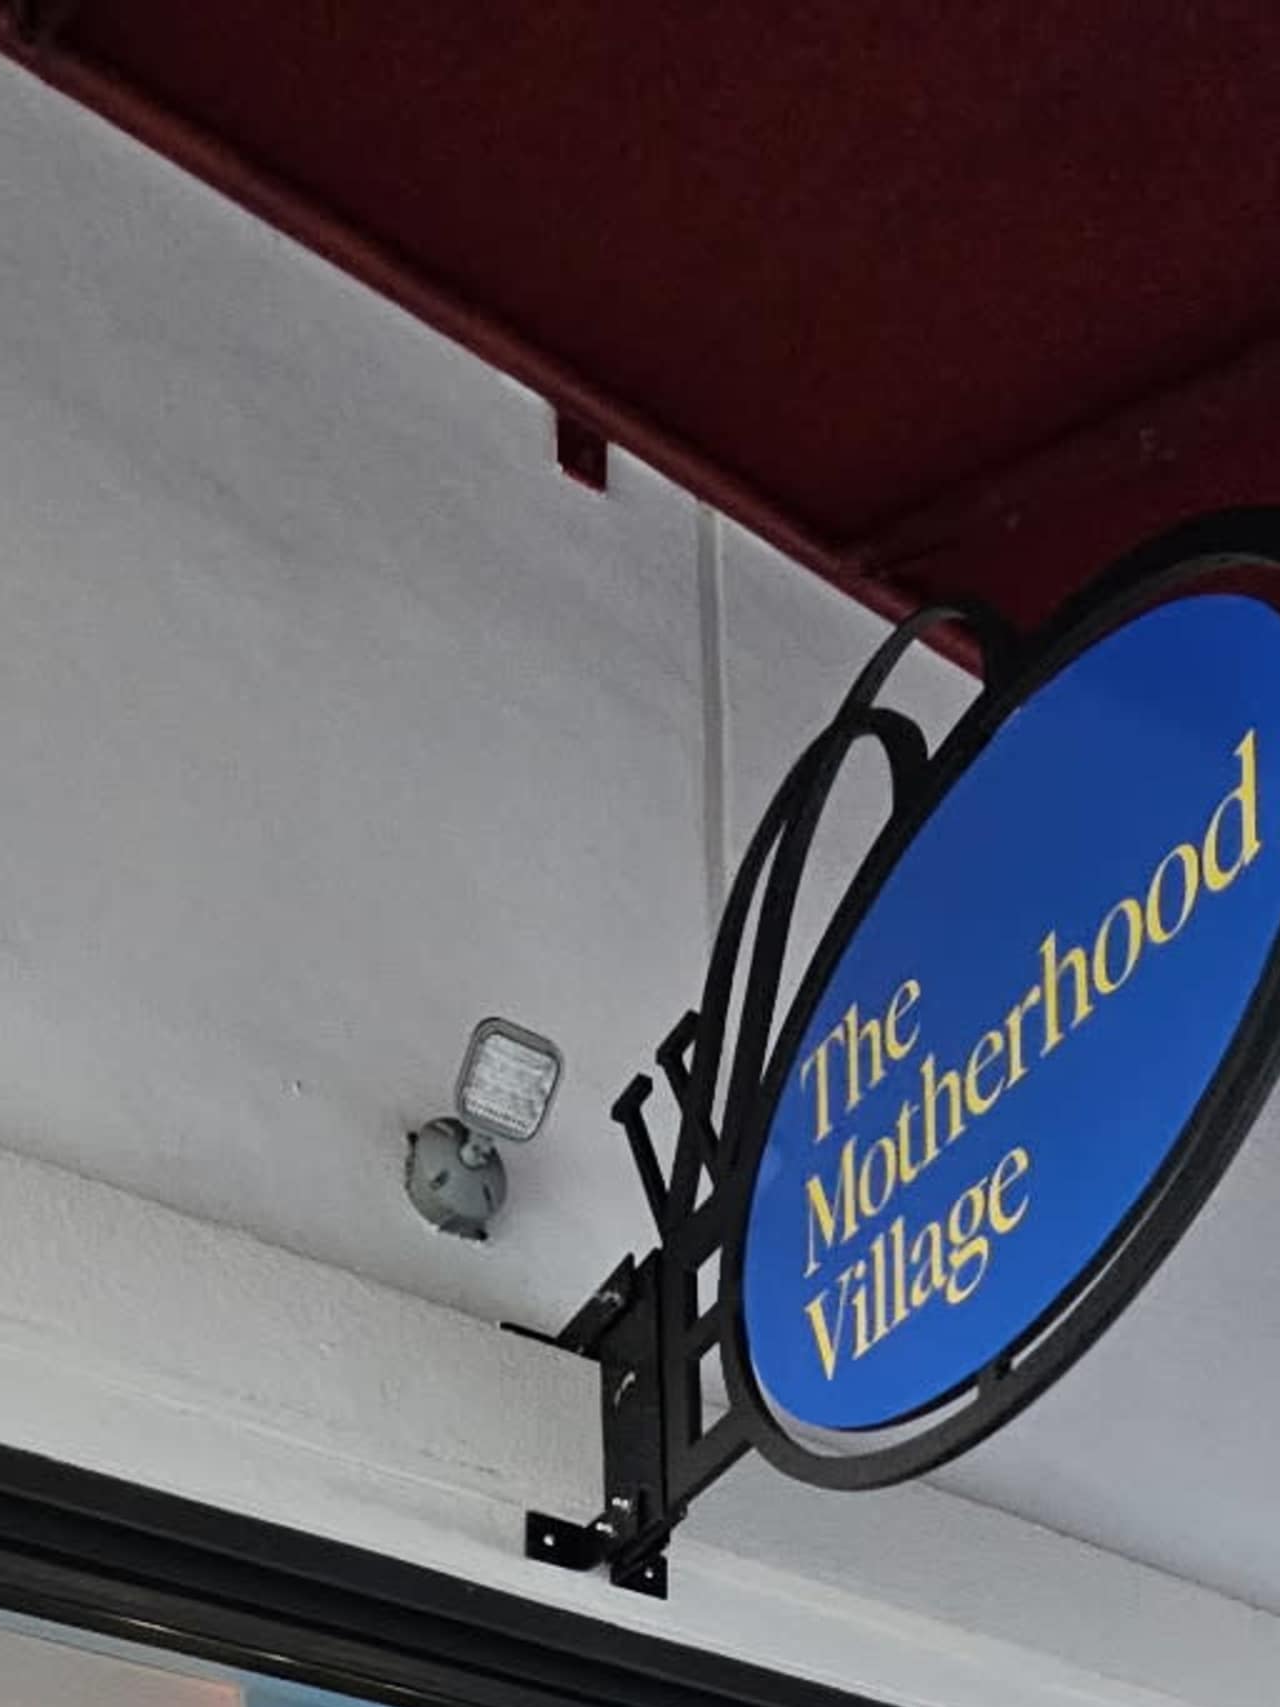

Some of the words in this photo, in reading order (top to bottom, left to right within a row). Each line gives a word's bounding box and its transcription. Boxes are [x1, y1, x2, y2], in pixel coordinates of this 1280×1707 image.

[800, 978, 922, 1145] The
[803, 729, 1262, 1279] Motherhood
[804, 1147, 1030, 1381] Village
